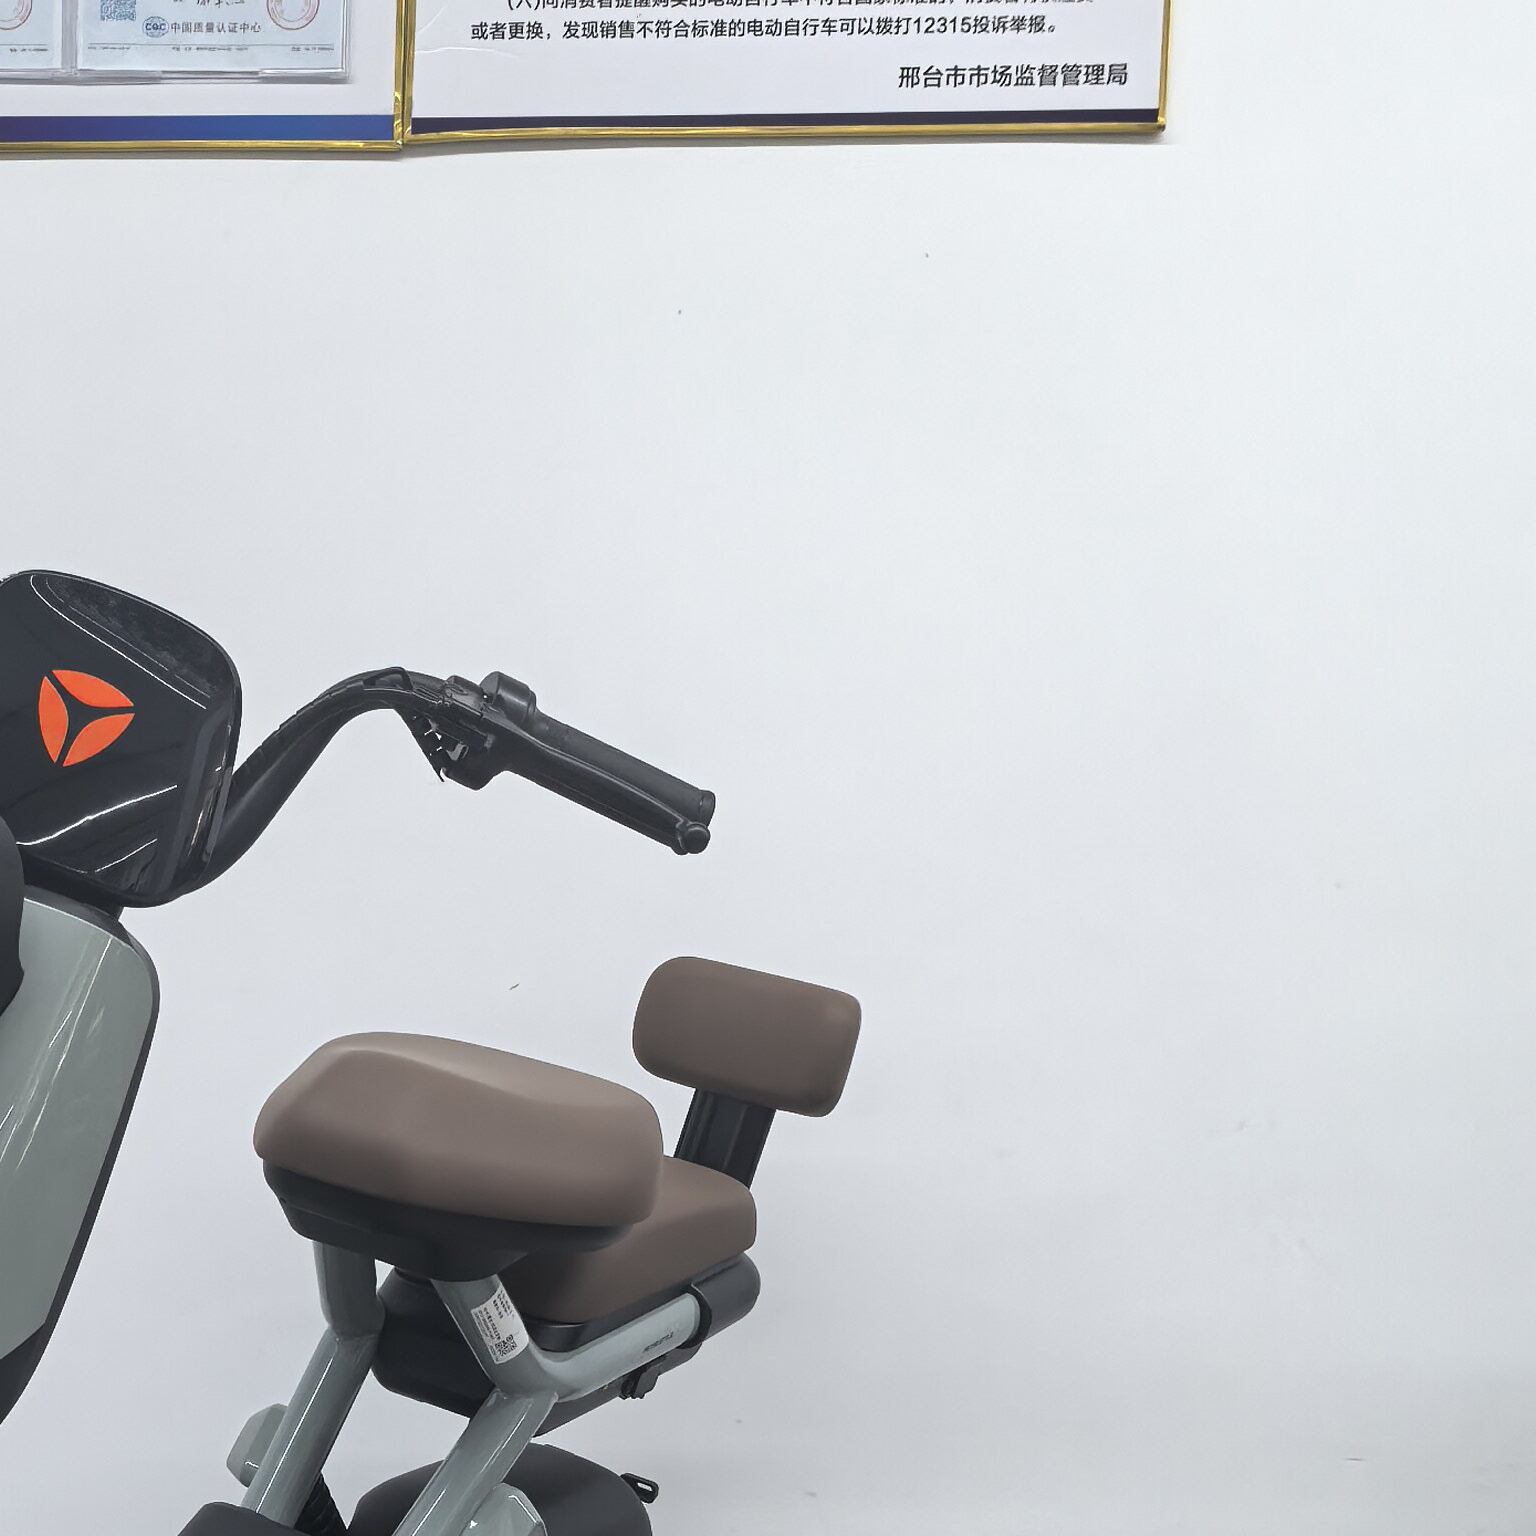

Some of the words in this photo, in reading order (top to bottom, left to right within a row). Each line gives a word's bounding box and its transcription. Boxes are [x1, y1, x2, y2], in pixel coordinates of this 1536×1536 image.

[170, 22, 261, 34] 中国质量认证中心
[471, 15, 1056, 40] 或者更换，发现销售不符合标准的电动自行车可以拨打12315投诉举报。
[898, 63, 1128, 88] 邢台市市场监督管理局
